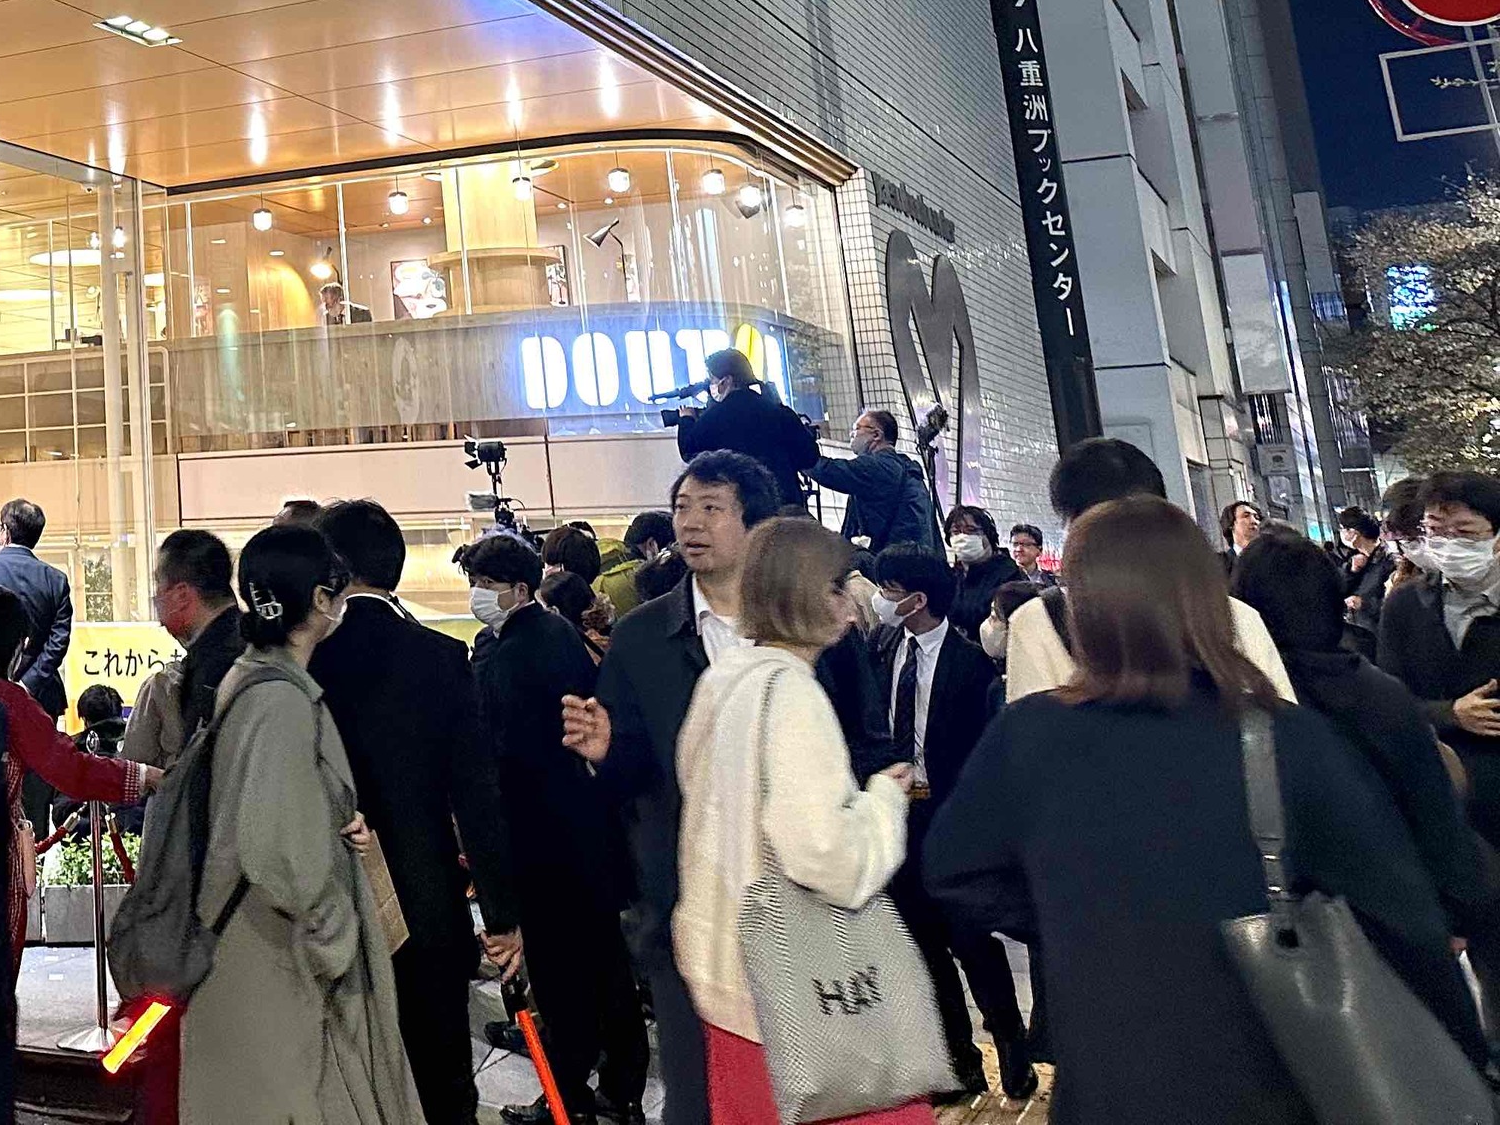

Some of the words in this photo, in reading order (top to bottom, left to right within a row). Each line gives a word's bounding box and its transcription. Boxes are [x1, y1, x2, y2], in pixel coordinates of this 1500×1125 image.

[1014, 27, 1075, 337] 八重洲ブックセンター
